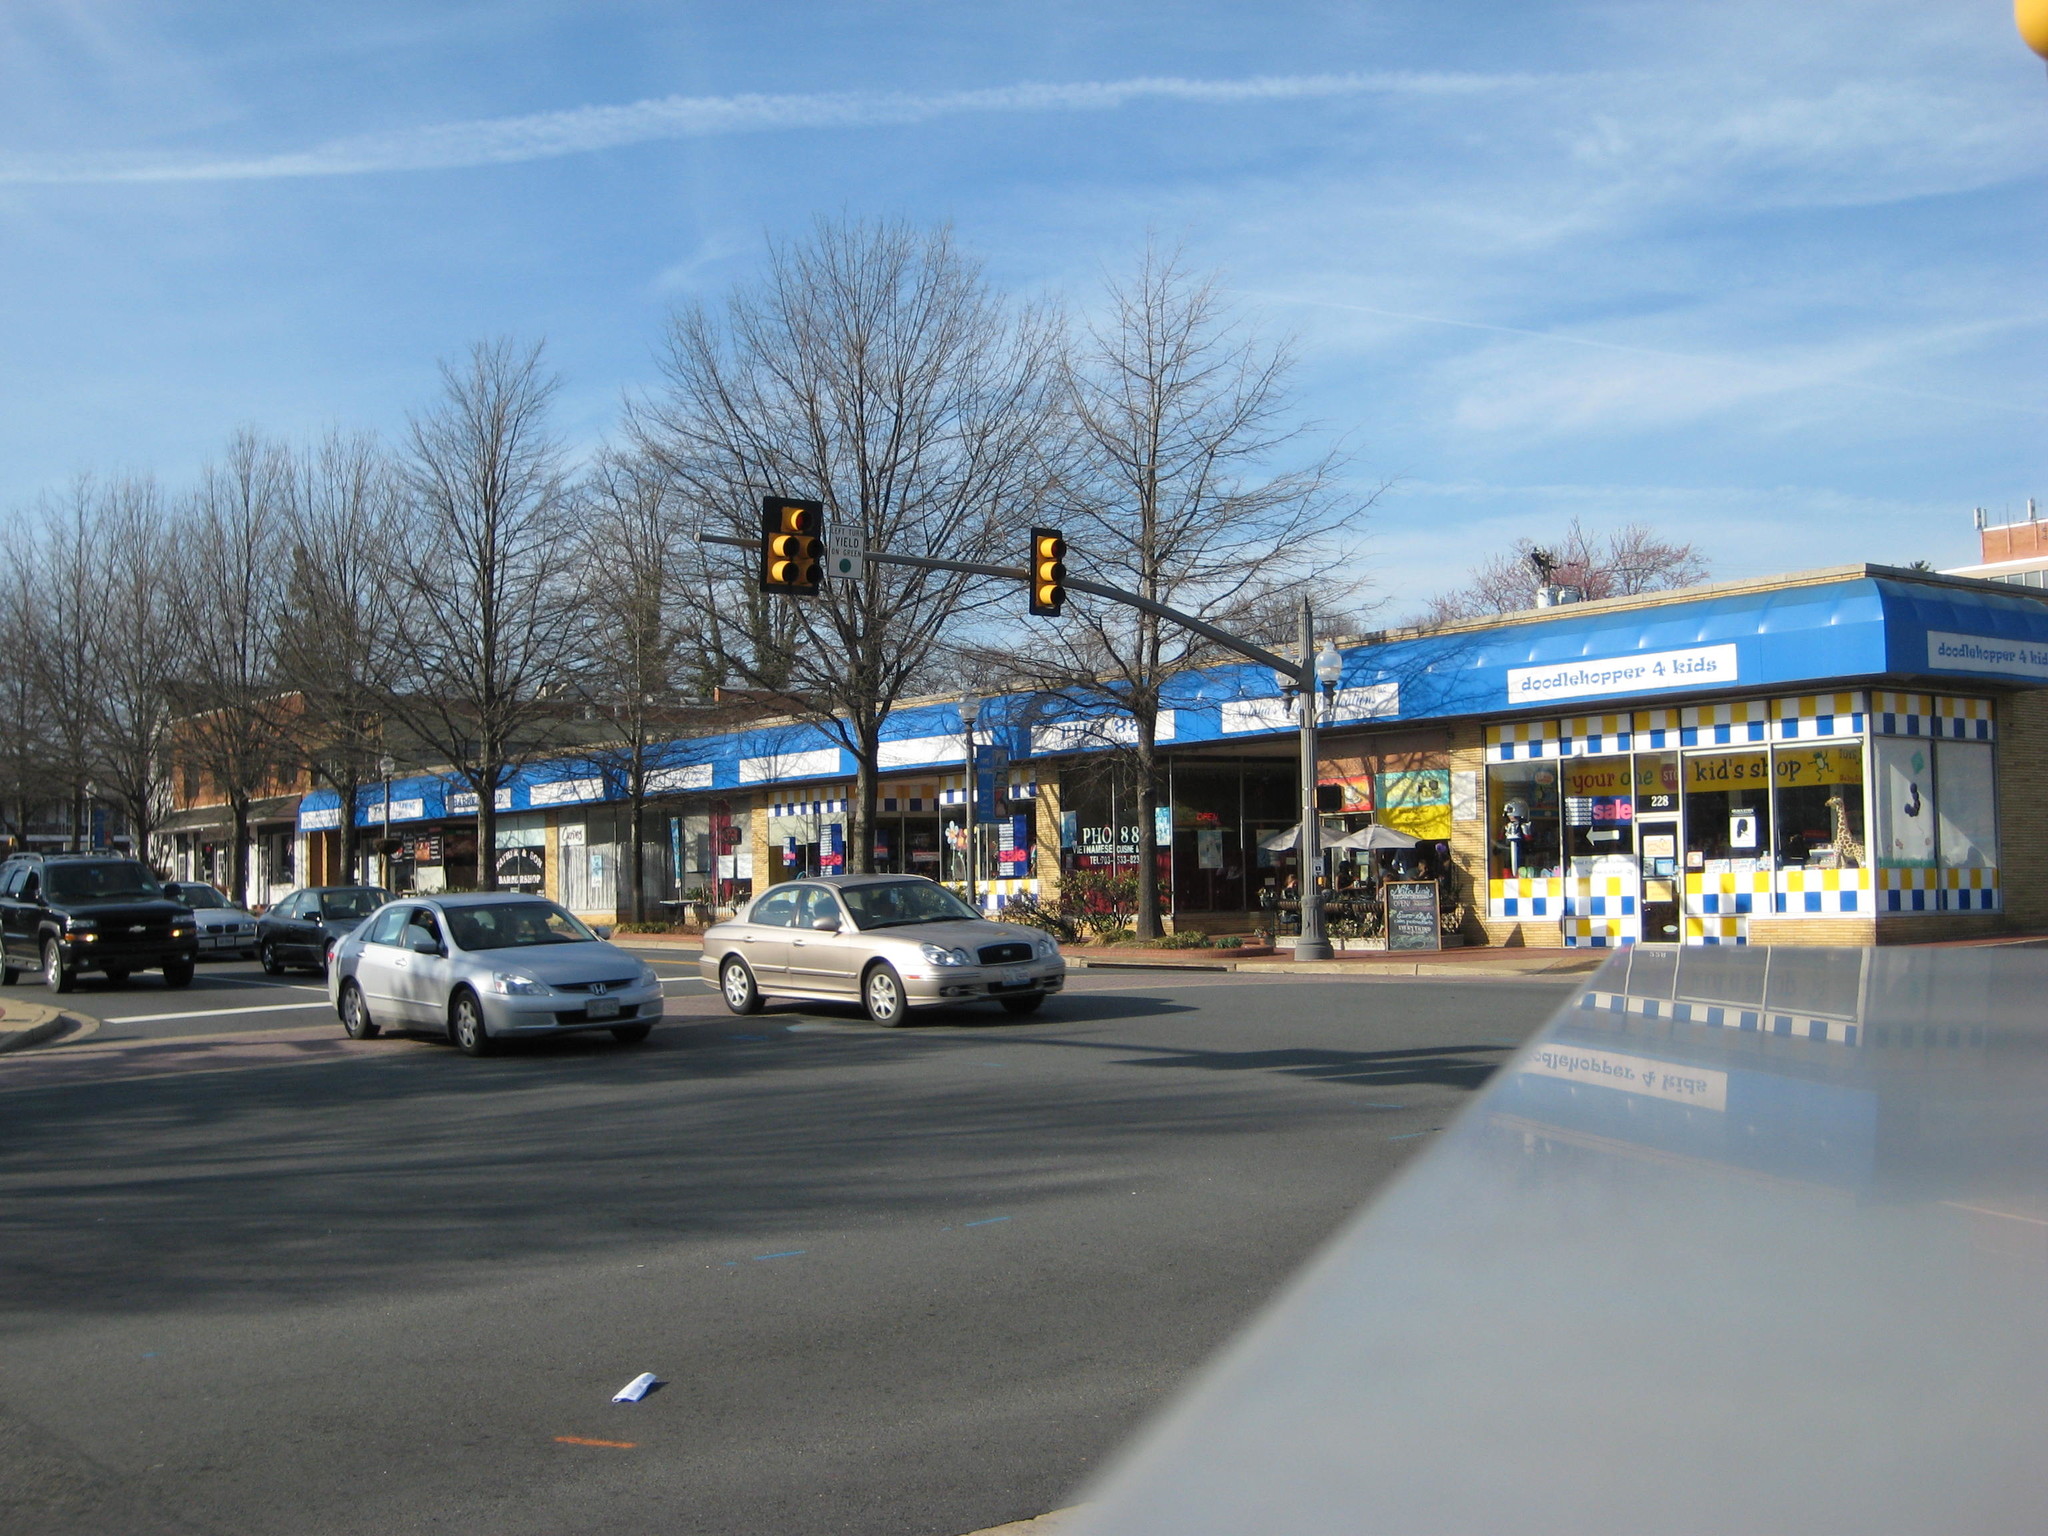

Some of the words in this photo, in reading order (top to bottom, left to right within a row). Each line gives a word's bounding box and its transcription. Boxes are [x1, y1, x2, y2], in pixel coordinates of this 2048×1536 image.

[831, 527, 845, 535] LEFT
[849, 529, 864, 537] TURN
[835, 536, 859, 549] YIELD
[843, 550, 862, 558] GREEN
[1938, 642, 2016, 664] doodlehopper
[2019, 650, 2027, 664] 4
[2030, 651, 2048, 666] kid
[1521, 668, 1646, 692] doodlehopper
[1653, 661, 1666, 677] 4
[1673, 657, 1718, 674] kids
[1573, 771, 1615, 794] your
[1620, 770, 1653, 787] one
[1695, 758, 1744, 781] kid's
[1750, 757, 1802, 782] shop
[1651, 795, 1669, 807] 228
[1593, 799, 1632, 820] sale
[1083, 826, 1113, 844] PHO
[1120, 826, 1140, 843] 88
[999, 846, 1028, 862] sale
[1072, 845, 1113, 854] VIETNAMESE
[1116, 845, 1133, 854] CUISINE
[530, 851, 543, 868] SON
[820, 851, 842, 866] sale
[498, 874, 541, 884] BARBERSHOP
